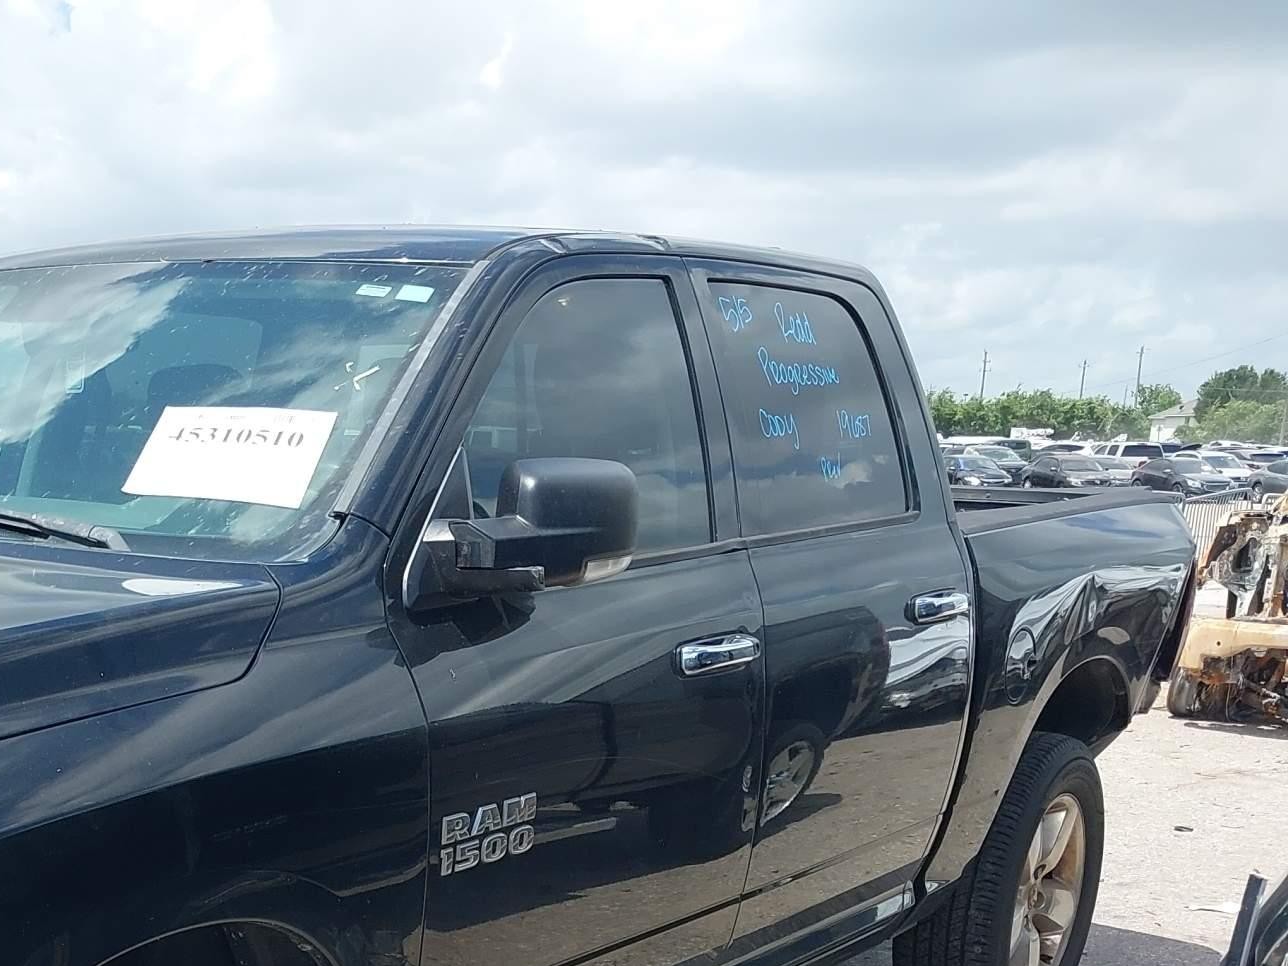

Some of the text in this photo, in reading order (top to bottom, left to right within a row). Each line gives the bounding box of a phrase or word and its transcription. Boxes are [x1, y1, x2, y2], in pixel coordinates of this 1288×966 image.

[168, 426, 304, 448] 45310510
[441, 792, 537, 846] RAM
[440, 824, 535, 877] 1500
